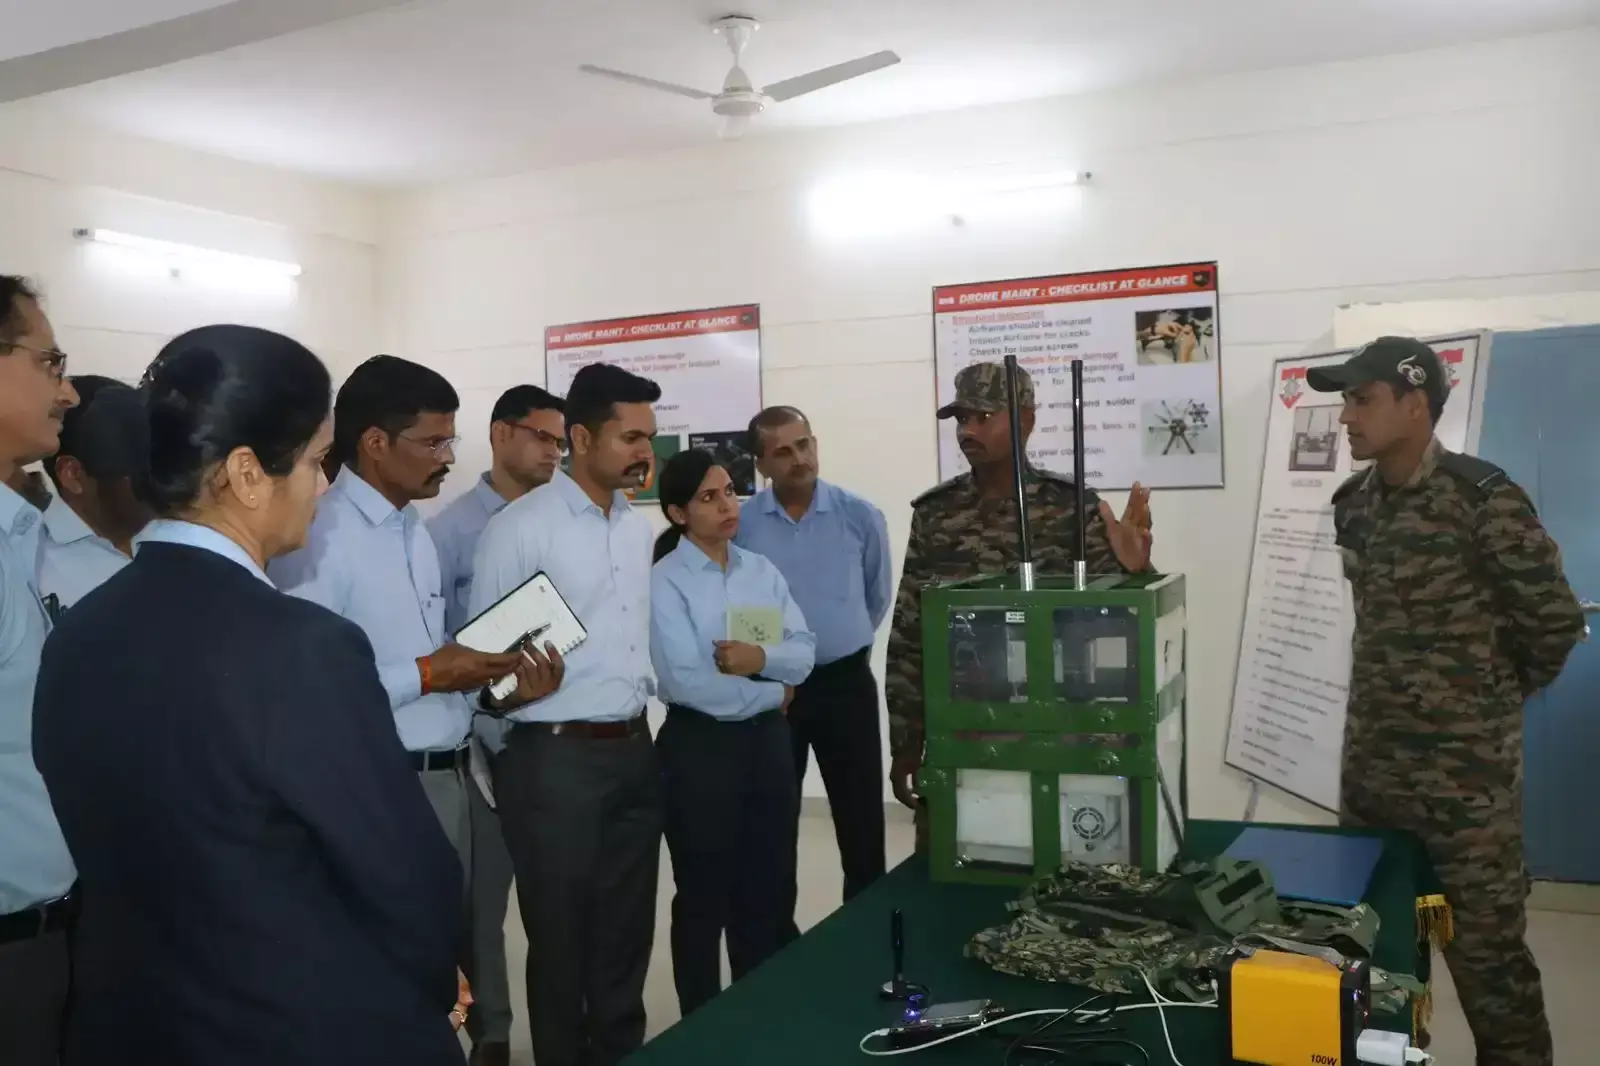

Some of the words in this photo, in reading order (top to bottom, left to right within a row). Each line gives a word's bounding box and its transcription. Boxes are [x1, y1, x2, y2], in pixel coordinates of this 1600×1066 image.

[959, 290, 999, 304] DRONE
[1001, 287, 1040, 301] MAINT
[1048, 281, 1115, 297] CHECKLIST
[1119, 279, 1135, 290] AT
[1137, 274, 1188, 289] GLANCE
[595, 327, 624, 338] MAINT
[630, 321, 682, 334] CHECKLIST
[684, 319, 697, 329] AT
[698, 315, 737, 328] GLANCE
[1004, 346, 1017, 355] for
[1310, 1053, 1337, 1066] 100W
